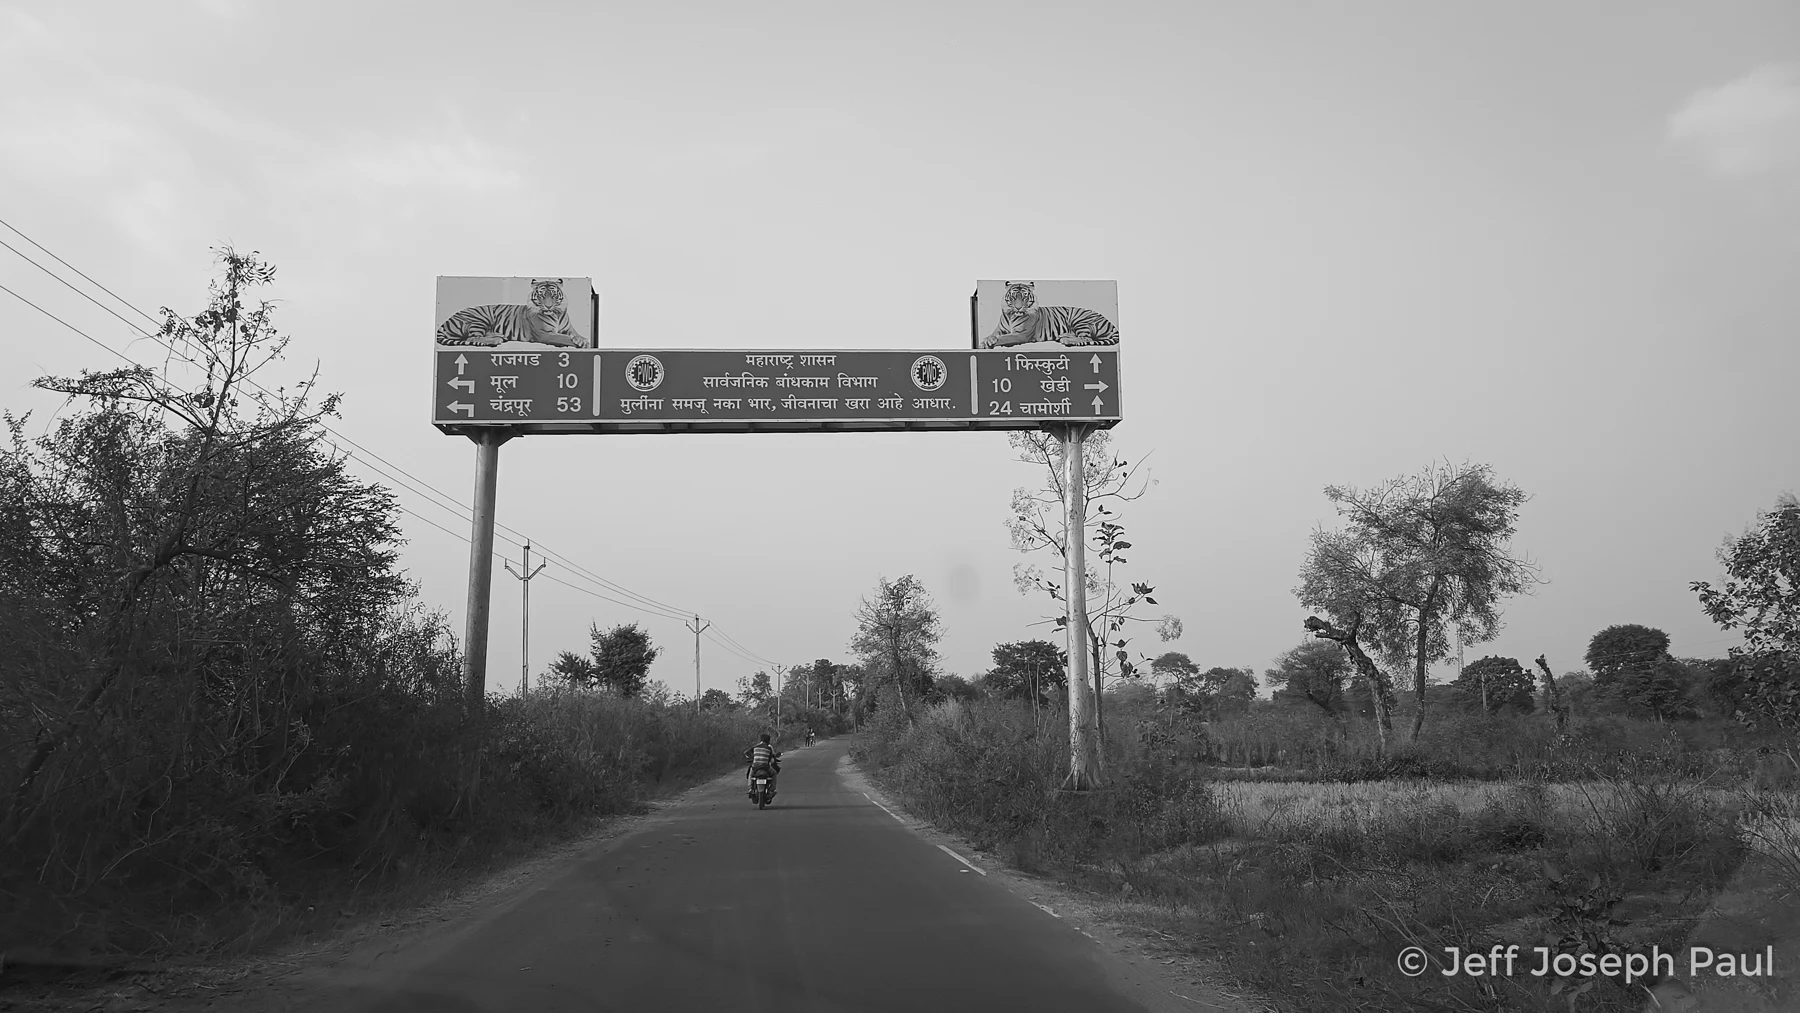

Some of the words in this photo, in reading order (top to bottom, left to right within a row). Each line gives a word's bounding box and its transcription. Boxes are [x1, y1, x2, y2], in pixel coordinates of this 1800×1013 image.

[490, 353, 542, 367] राजगड
[557, 352, 570, 368] 3
[745, 354, 794, 370] महाराष्ट्र
[799, 354, 837, 367] शासन
[1004, 356, 1012, 371] 1
[1014, 353, 1071, 376] फिस्कुटी
[637, 364, 654, 382] PWD
[702, 371, 770, 389] सार्वजनिक
[775, 372, 830, 389] बांधकाम
[836, 372, 879, 389] विभाग
[922, 364, 937, 382] PWD
[489, 375, 519, 394] मूल
[556, 373, 579, 389] 10
[992, 377, 1012, 393] 10
[1040, 375, 1071, 393] खेडी
[489, 395, 533, 417] चंद्रपूर
[556, 396, 582, 412] 53
[672, 398, 709, 415] समजू
[713, 398, 742, 410] नका
[747, 398, 777, 412] भार,
[780, 393, 838, 410] जीवनाचा
[845, 398, 871, 410] खरा
[877, 392, 904, 411] आहे
[911, 398, 956, 410] आधार.
[989, 400, 1012, 416] 24
[1019, 397, 1072, 416] चामोर्शी
